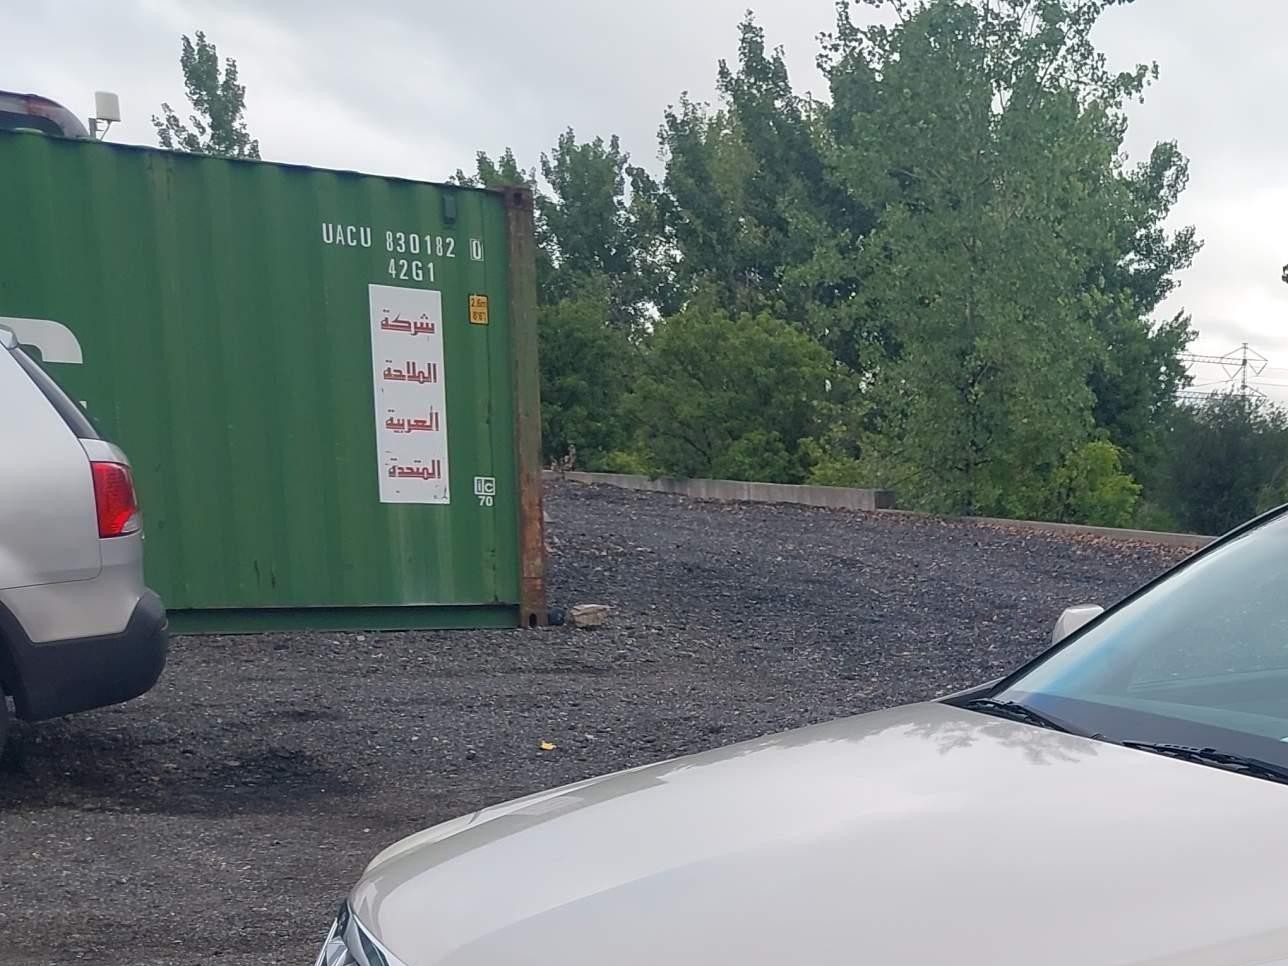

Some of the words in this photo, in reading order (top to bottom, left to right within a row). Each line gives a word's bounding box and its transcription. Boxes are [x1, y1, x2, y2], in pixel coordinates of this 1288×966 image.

[322, 223, 373, 247] UACU
[386, 231, 456, 258] 830182
[388, 258, 435, 282] 42G1
[380, 309, 436, 336] شركة
[383, 360, 438, 384] الملاحة
[385, 409, 439, 434] العربية
[388, 458, 441, 481] المتحدة
[478, 496, 493, 507] 70
